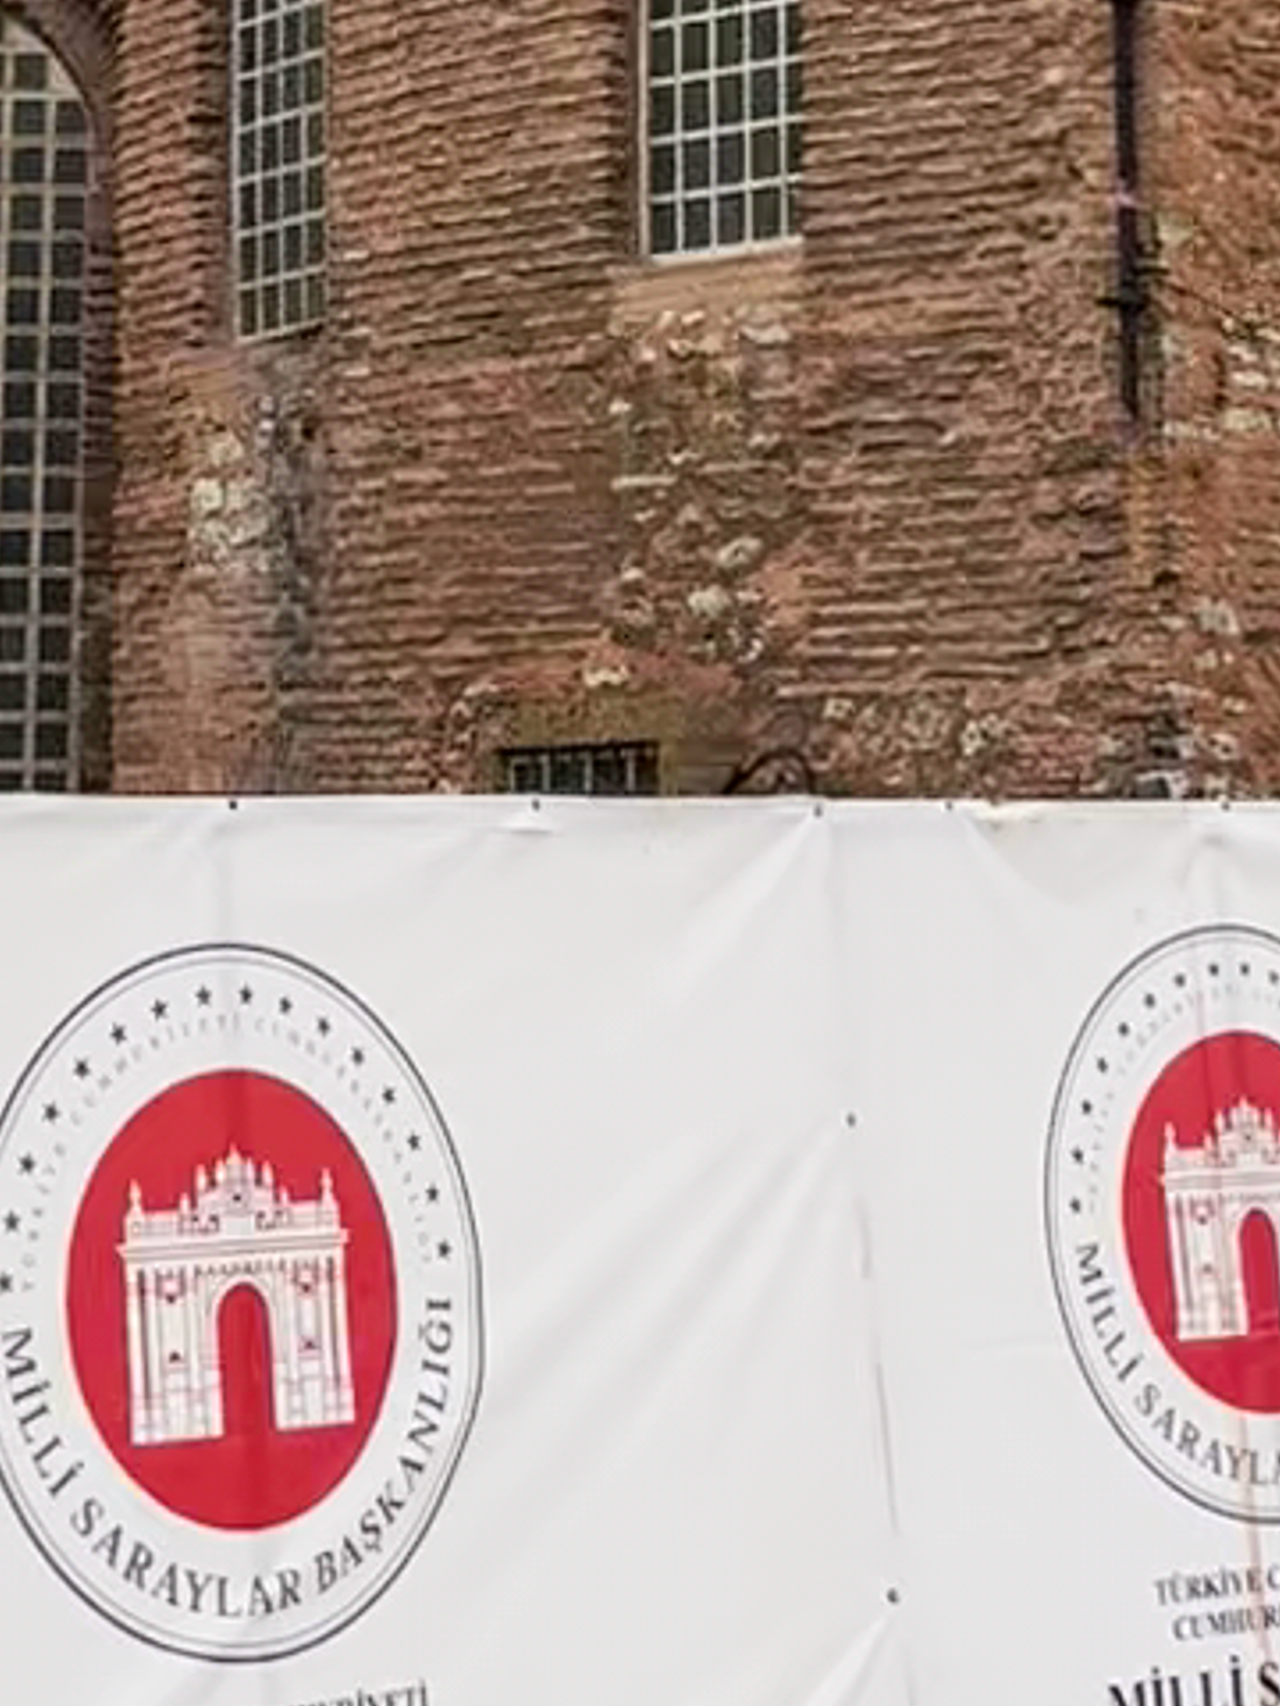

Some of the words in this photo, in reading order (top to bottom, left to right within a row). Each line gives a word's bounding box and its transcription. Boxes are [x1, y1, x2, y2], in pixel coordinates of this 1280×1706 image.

[1, 1326, 86, 1499] MİLLİ
[70, 1497, 302, 1619] SARAYLAR
[314, 1297, 453, 1594] BAŞKANLIĞI
[1154, 1568, 1262, 1607] TÜRKİYE
